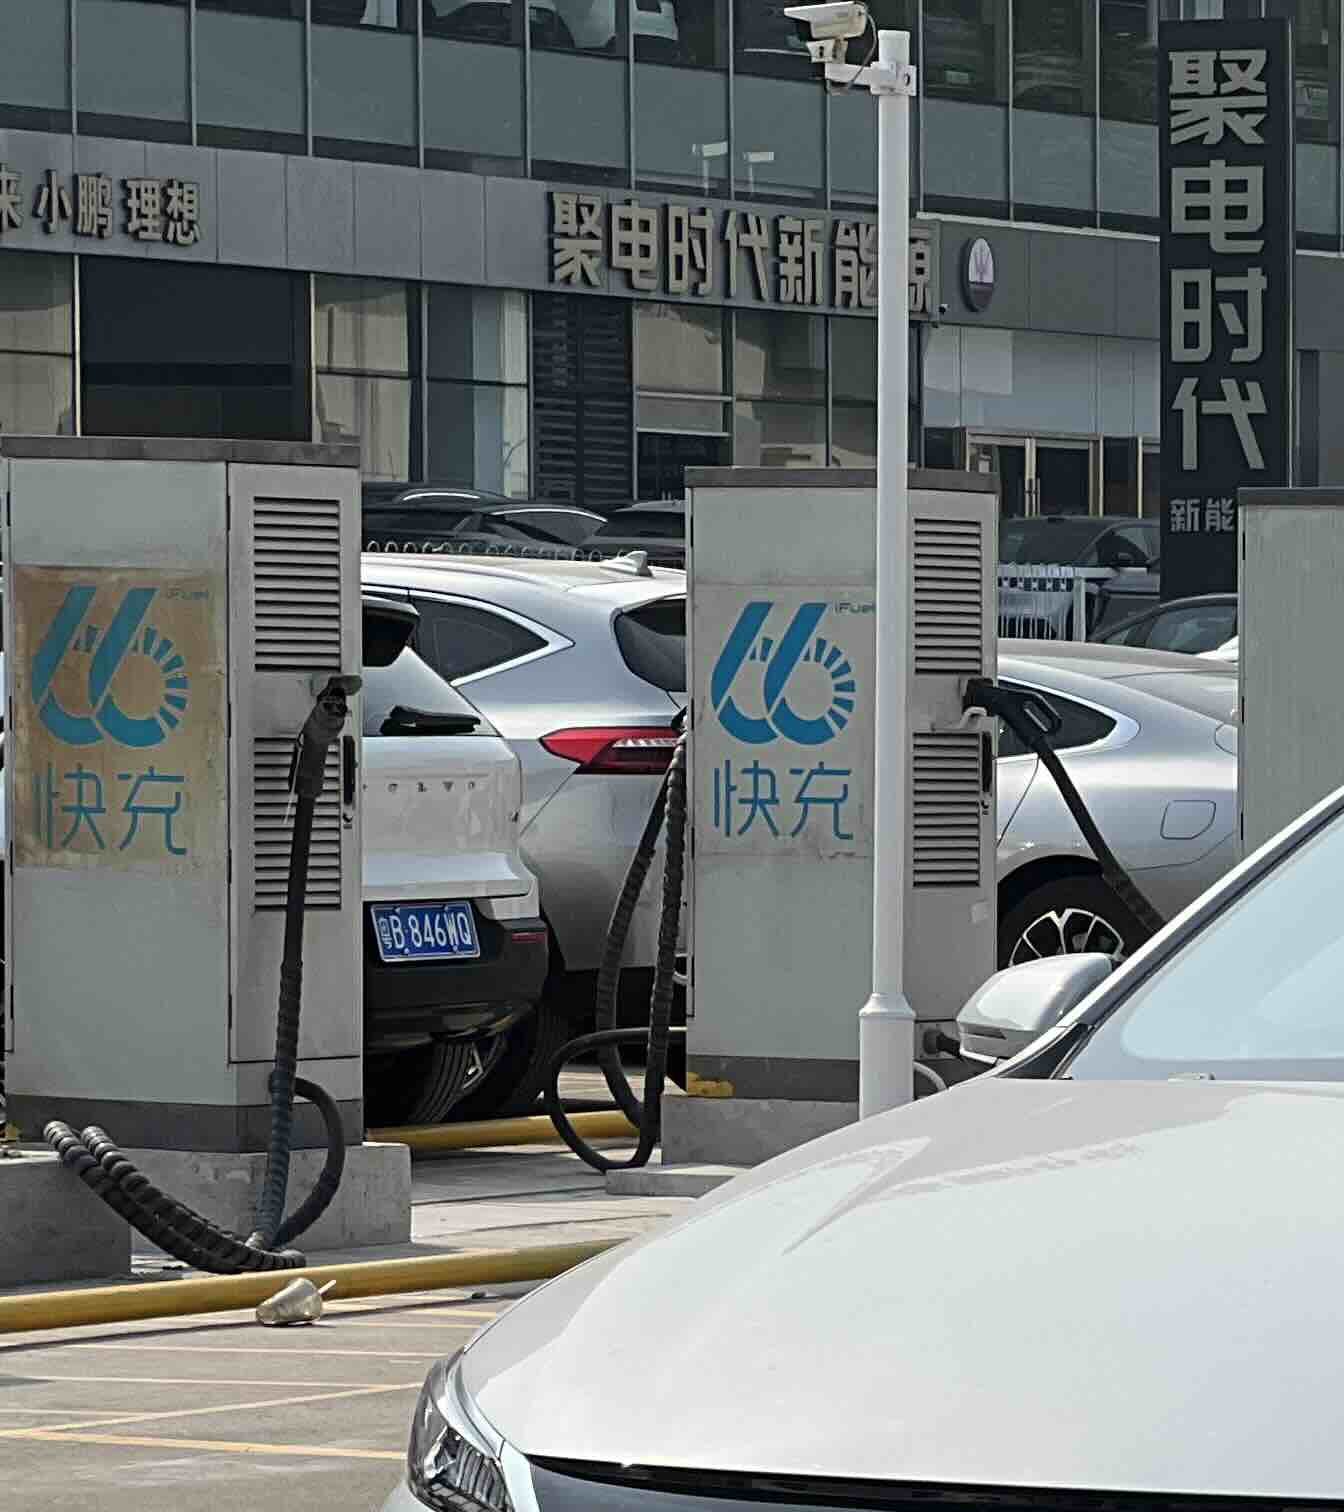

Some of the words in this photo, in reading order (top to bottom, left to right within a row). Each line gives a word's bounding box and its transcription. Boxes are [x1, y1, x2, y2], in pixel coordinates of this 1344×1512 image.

[34, 169, 113, 240] 小鹏
[123, 178, 201, 245] 理想
[1168, 49, 1268, 471] 聚电时代
[1169, 498, 1233, 532] 新能
[33, 760, 188, 857] 快充
[713, 759, 854, 841] 快充
